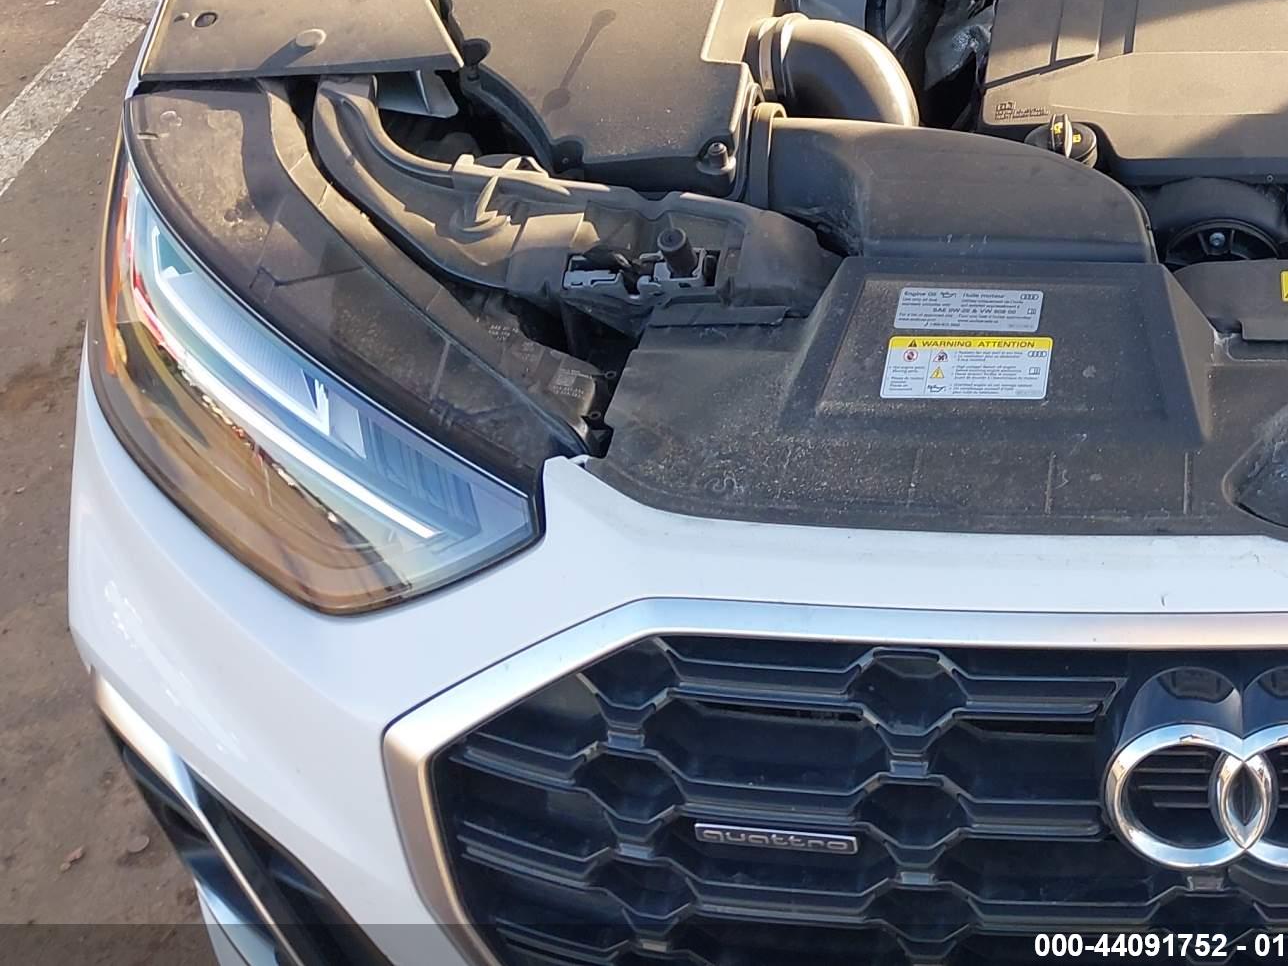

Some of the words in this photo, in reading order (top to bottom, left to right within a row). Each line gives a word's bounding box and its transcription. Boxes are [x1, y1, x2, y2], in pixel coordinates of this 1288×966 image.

[921, 340, 972, 348] WARNING
[977, 340, 1035, 348] ATTENTION
[702, 829, 850, 851] quattro
